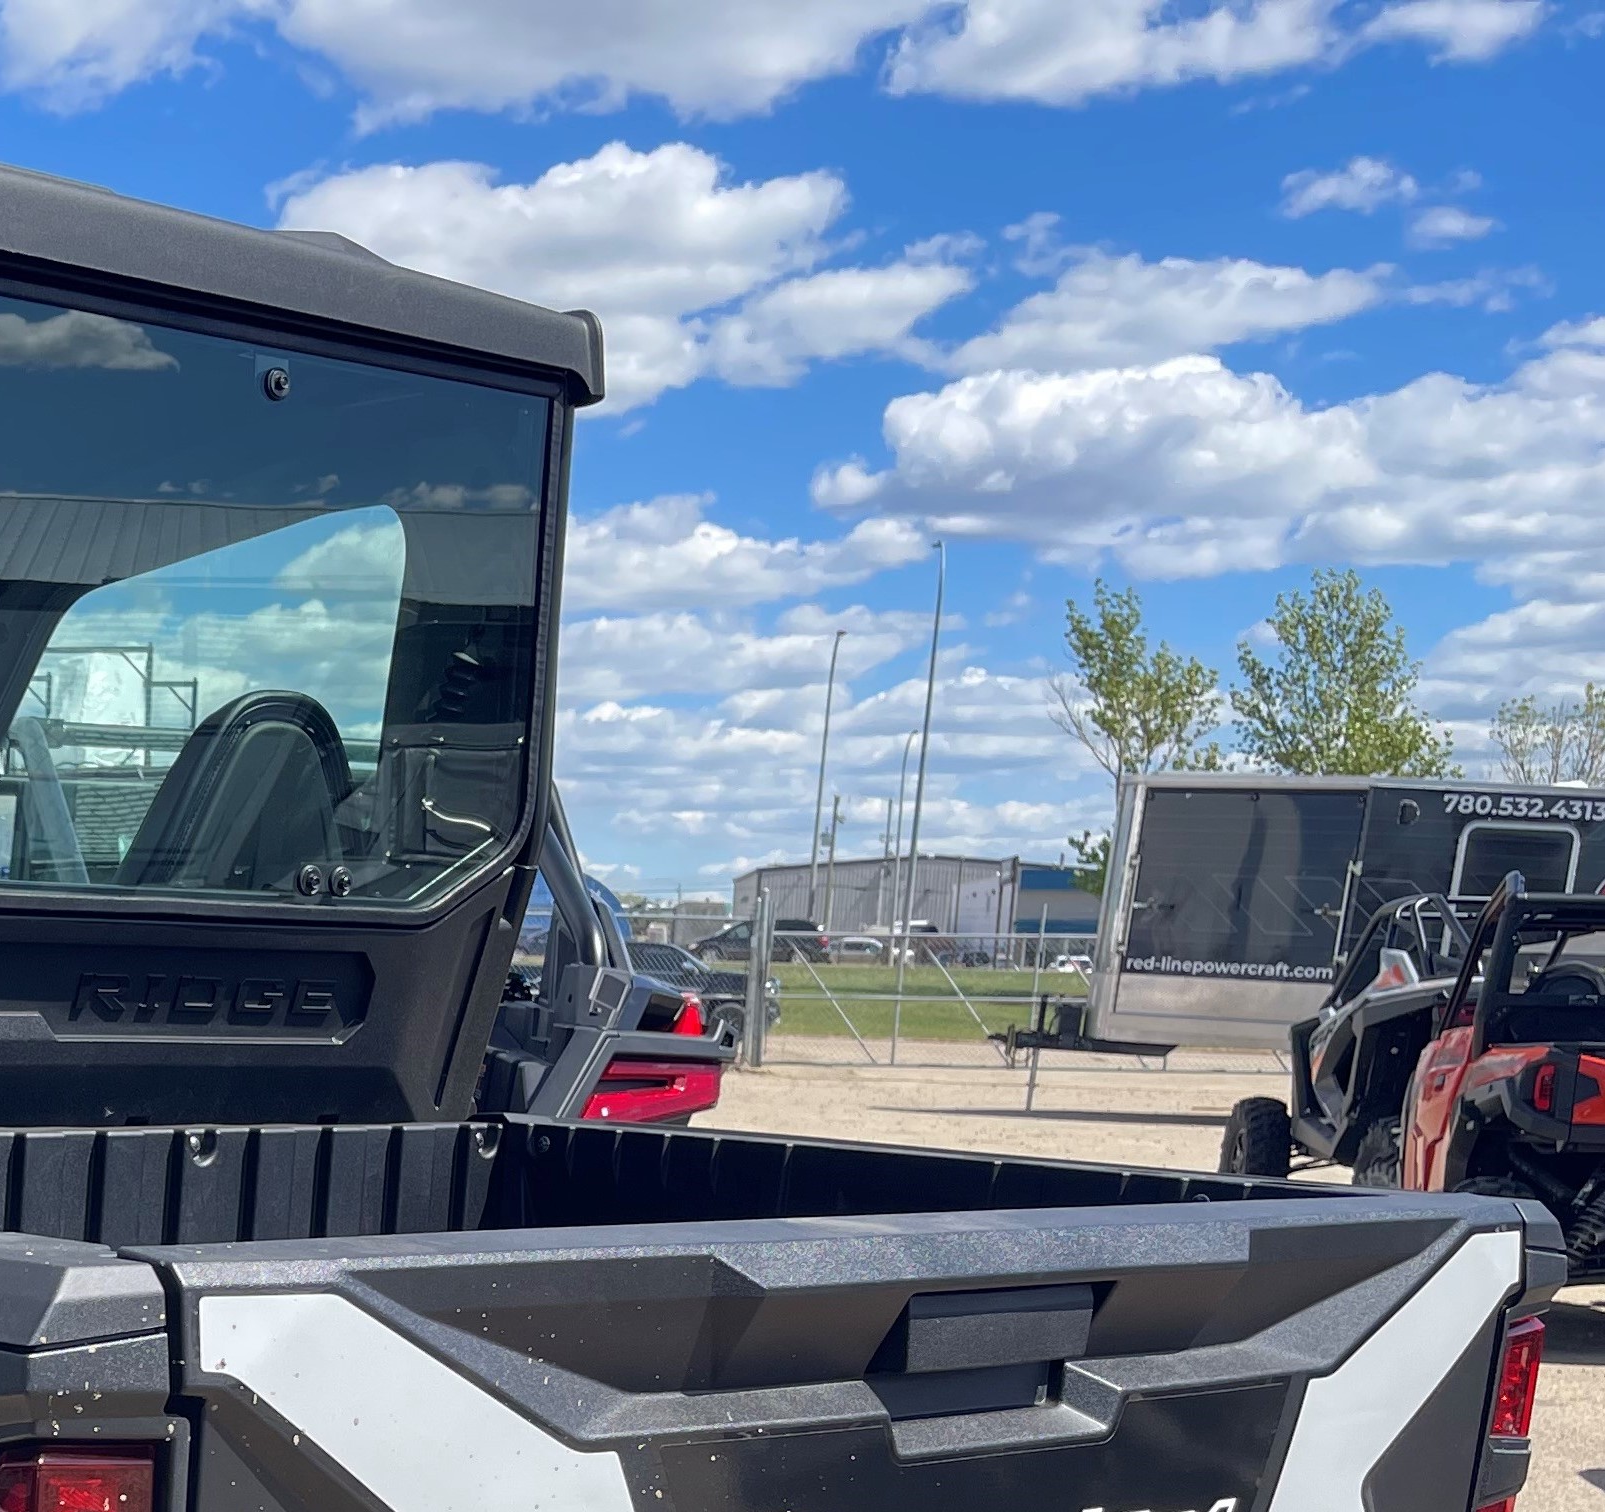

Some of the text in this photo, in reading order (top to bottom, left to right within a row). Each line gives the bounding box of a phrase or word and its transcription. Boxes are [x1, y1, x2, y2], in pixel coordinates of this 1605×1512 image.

[1443, 794, 1605, 822] 780.532.4313
[1126, 955, 1334, 980] red-linepowercraft.com
[68, 972, 338, 1025] RIDGE
